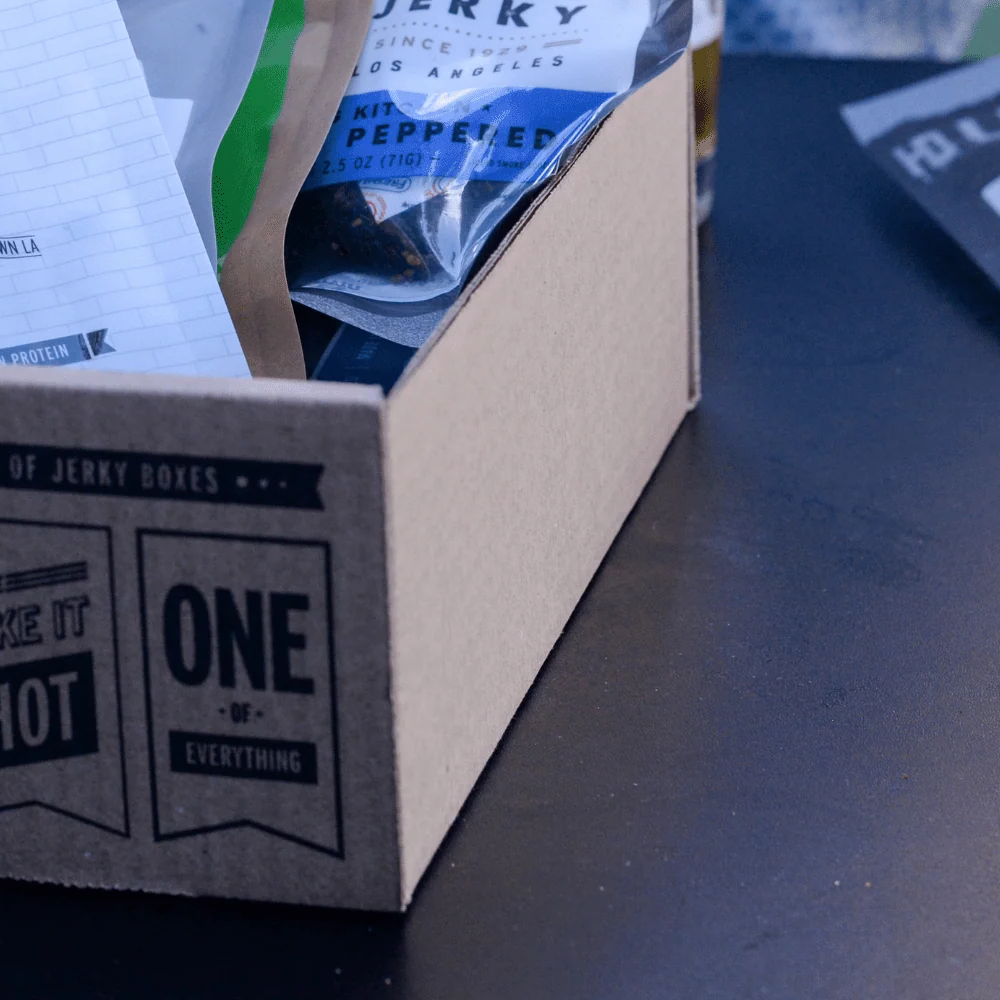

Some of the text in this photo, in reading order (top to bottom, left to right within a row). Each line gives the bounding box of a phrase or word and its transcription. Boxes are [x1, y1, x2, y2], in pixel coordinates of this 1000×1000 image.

[374, 36, 528, 58] SINCE 1929
[352, 55, 564, 79] LOS ANGELES
[322, 158, 347, 175] 2.5
[354, 155, 373, 170] OZ
[21, 238, 40, 254] LA
[10, 343, 70, 365] PROTEIN
[9, 454, 38, 481] OF
[52, 457, 128, 488] JERKY
[141, 462, 220, 494] BOXES
[51, 595, 92, 641] IT
[162, 583, 316, 695] ONE
[229, 703, 252, 724] OF
[185, 741, 302, 774] EVERYTHING
